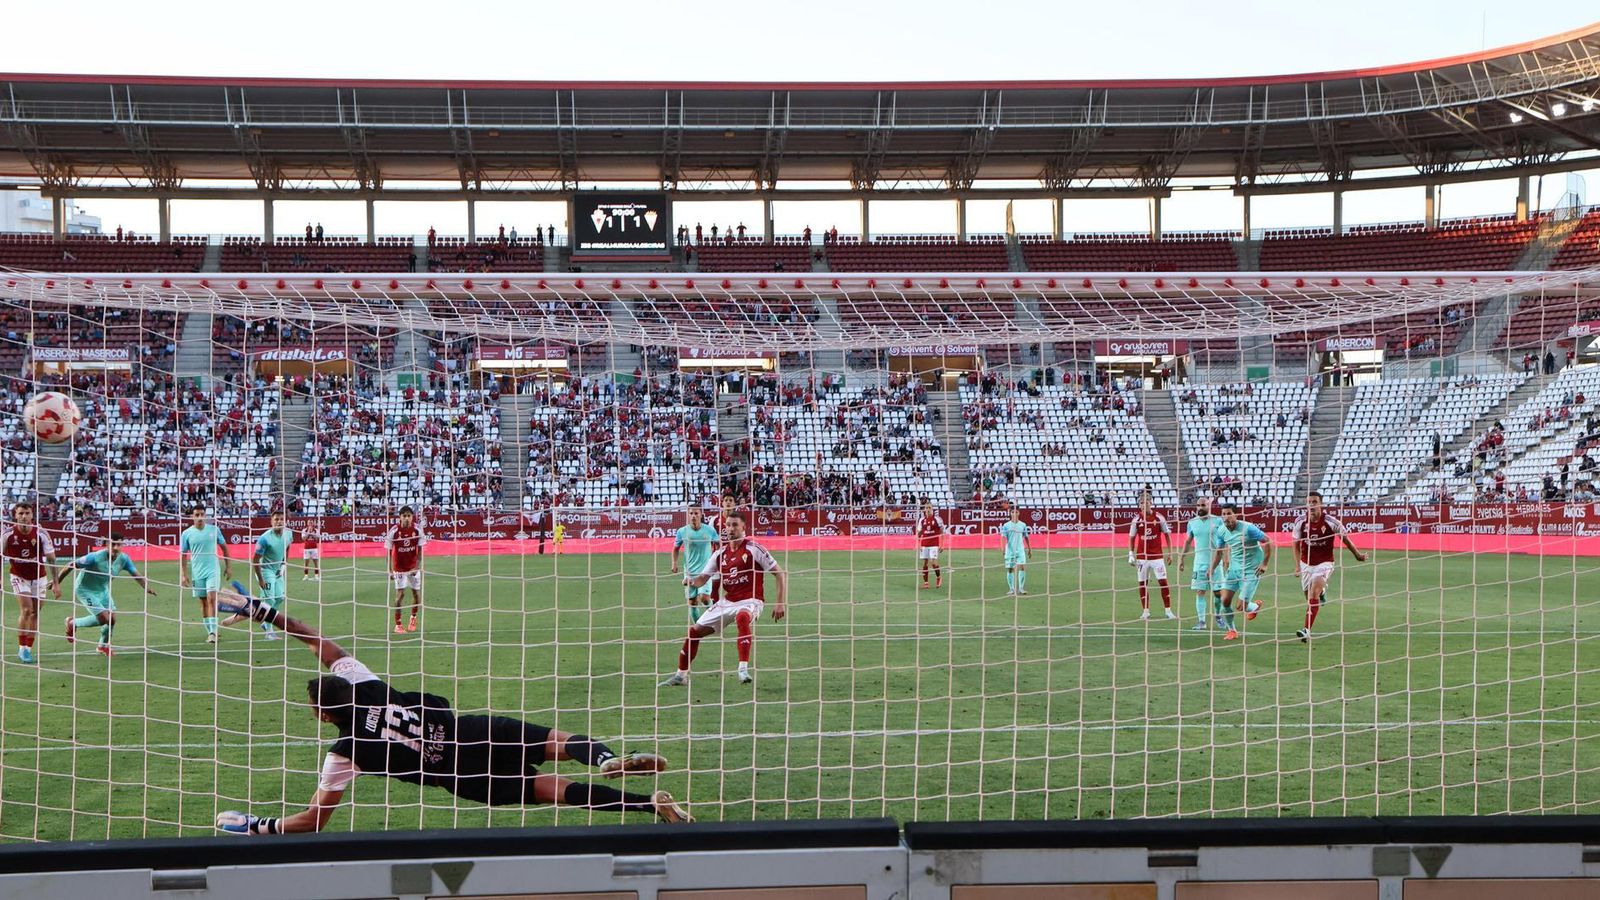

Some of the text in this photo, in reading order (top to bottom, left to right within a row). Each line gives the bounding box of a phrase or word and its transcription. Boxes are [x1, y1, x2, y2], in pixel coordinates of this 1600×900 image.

[1326, 337, 1374, 350] MASERCON
[901, 344, 979, 353] Solvent Solvent
[33, 348, 129, 359] MASERCON MASERCON
[1103, 511, 1139, 519] UNIVERS
[1166, 510, 1200, 518] LEVAN
[1338, 508, 1377, 517] LEVANTE
[354, 517, 401, 526] MESEGUER
[860, 525, 913, 535] NORMATEX
[943, 524, 977, 535] KFC
[381, 703, 422, 752] 13
